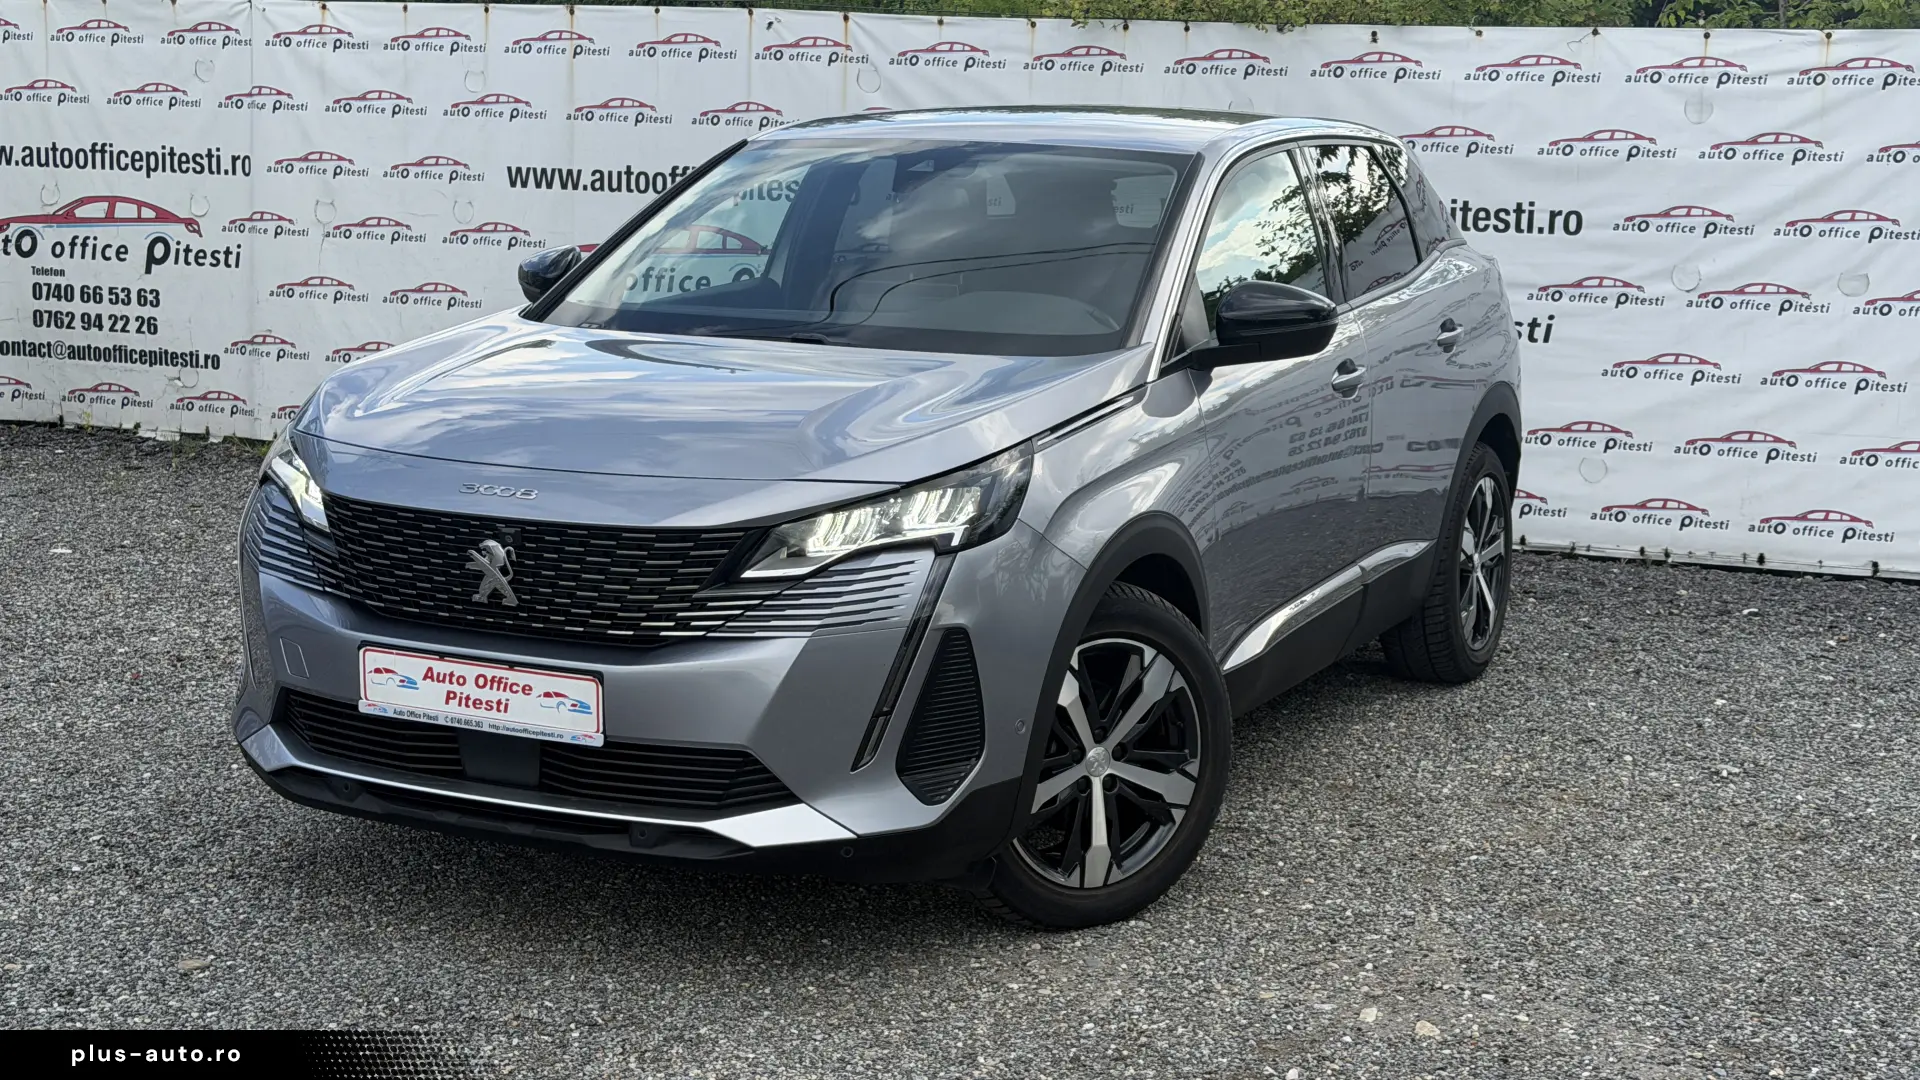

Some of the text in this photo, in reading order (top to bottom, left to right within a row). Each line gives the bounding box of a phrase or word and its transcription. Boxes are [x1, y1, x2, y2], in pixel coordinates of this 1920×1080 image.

[79, 33, 105, 43] office
[189, 36, 216, 45] office
[296, 39, 327, 48] office
[415, 42, 444, 51] office
[537, 45, 566, 54] office
[661, 48, 692, 58] office
[789, 52, 821, 62] office
[924, 57, 958, 67] office
[1060, 61, 1094, 71] office
[1202, 64, 1237, 75] office
[1350, 68, 1387, 78] office
[1506, 71, 1545, 82] office
[1668, 73, 1709, 84] office
[1832, 74, 1874, 85] office
[26, 93, 52, 102] office
[136, 97, 163, 106] office
[357, 104, 386, 114] office
[475, 108, 504, 118] office
[599, 112, 628, 122] office
[725, 117, 753, 127] office
[1422, 142, 1459, 153] office
[1580, 146, 1619, 157] office
[1743, 149, 1784, 161] office
[299, 165, 327, 175] office
[414, 170, 443, 180] office
[1656, 222, 1696, 233] office
[1818, 227, 1860, 238] office
[356, 231, 385, 240] office
[473, 236, 502, 246] office
[51, 235, 129, 262] office
[31, 266, 65, 277] Telefon
[32, 282, 160, 308] 0740 66 53 63
[299, 290, 328, 300] office
[1569, 292, 1608, 304] office
[413, 296, 442, 306] office
[1730, 299, 1771, 311] office
[32, 309, 158, 335] 0762 94 22 26
[0, 340, 220, 370] ontact@autoofficepitesti.ro
[1644, 369, 1683, 381] office
[1805, 377, 1847, 389] office
[88, 395, 116, 407] office
[198, 404, 225, 413] office
[1558, 436, 1596, 448] office
[1717, 447, 1758, 458] office
[459, 482, 538, 500] 3008
[1632, 514, 1672, 526] office
[1792, 525, 1834, 538] office
[422, 666, 533, 696] Auto Office
[444, 690, 510, 714] Pitesti
[393, 708, 405, 717] Auto
[406, 710, 422, 720] Office
[422, 712, 439, 722] Pitesti
